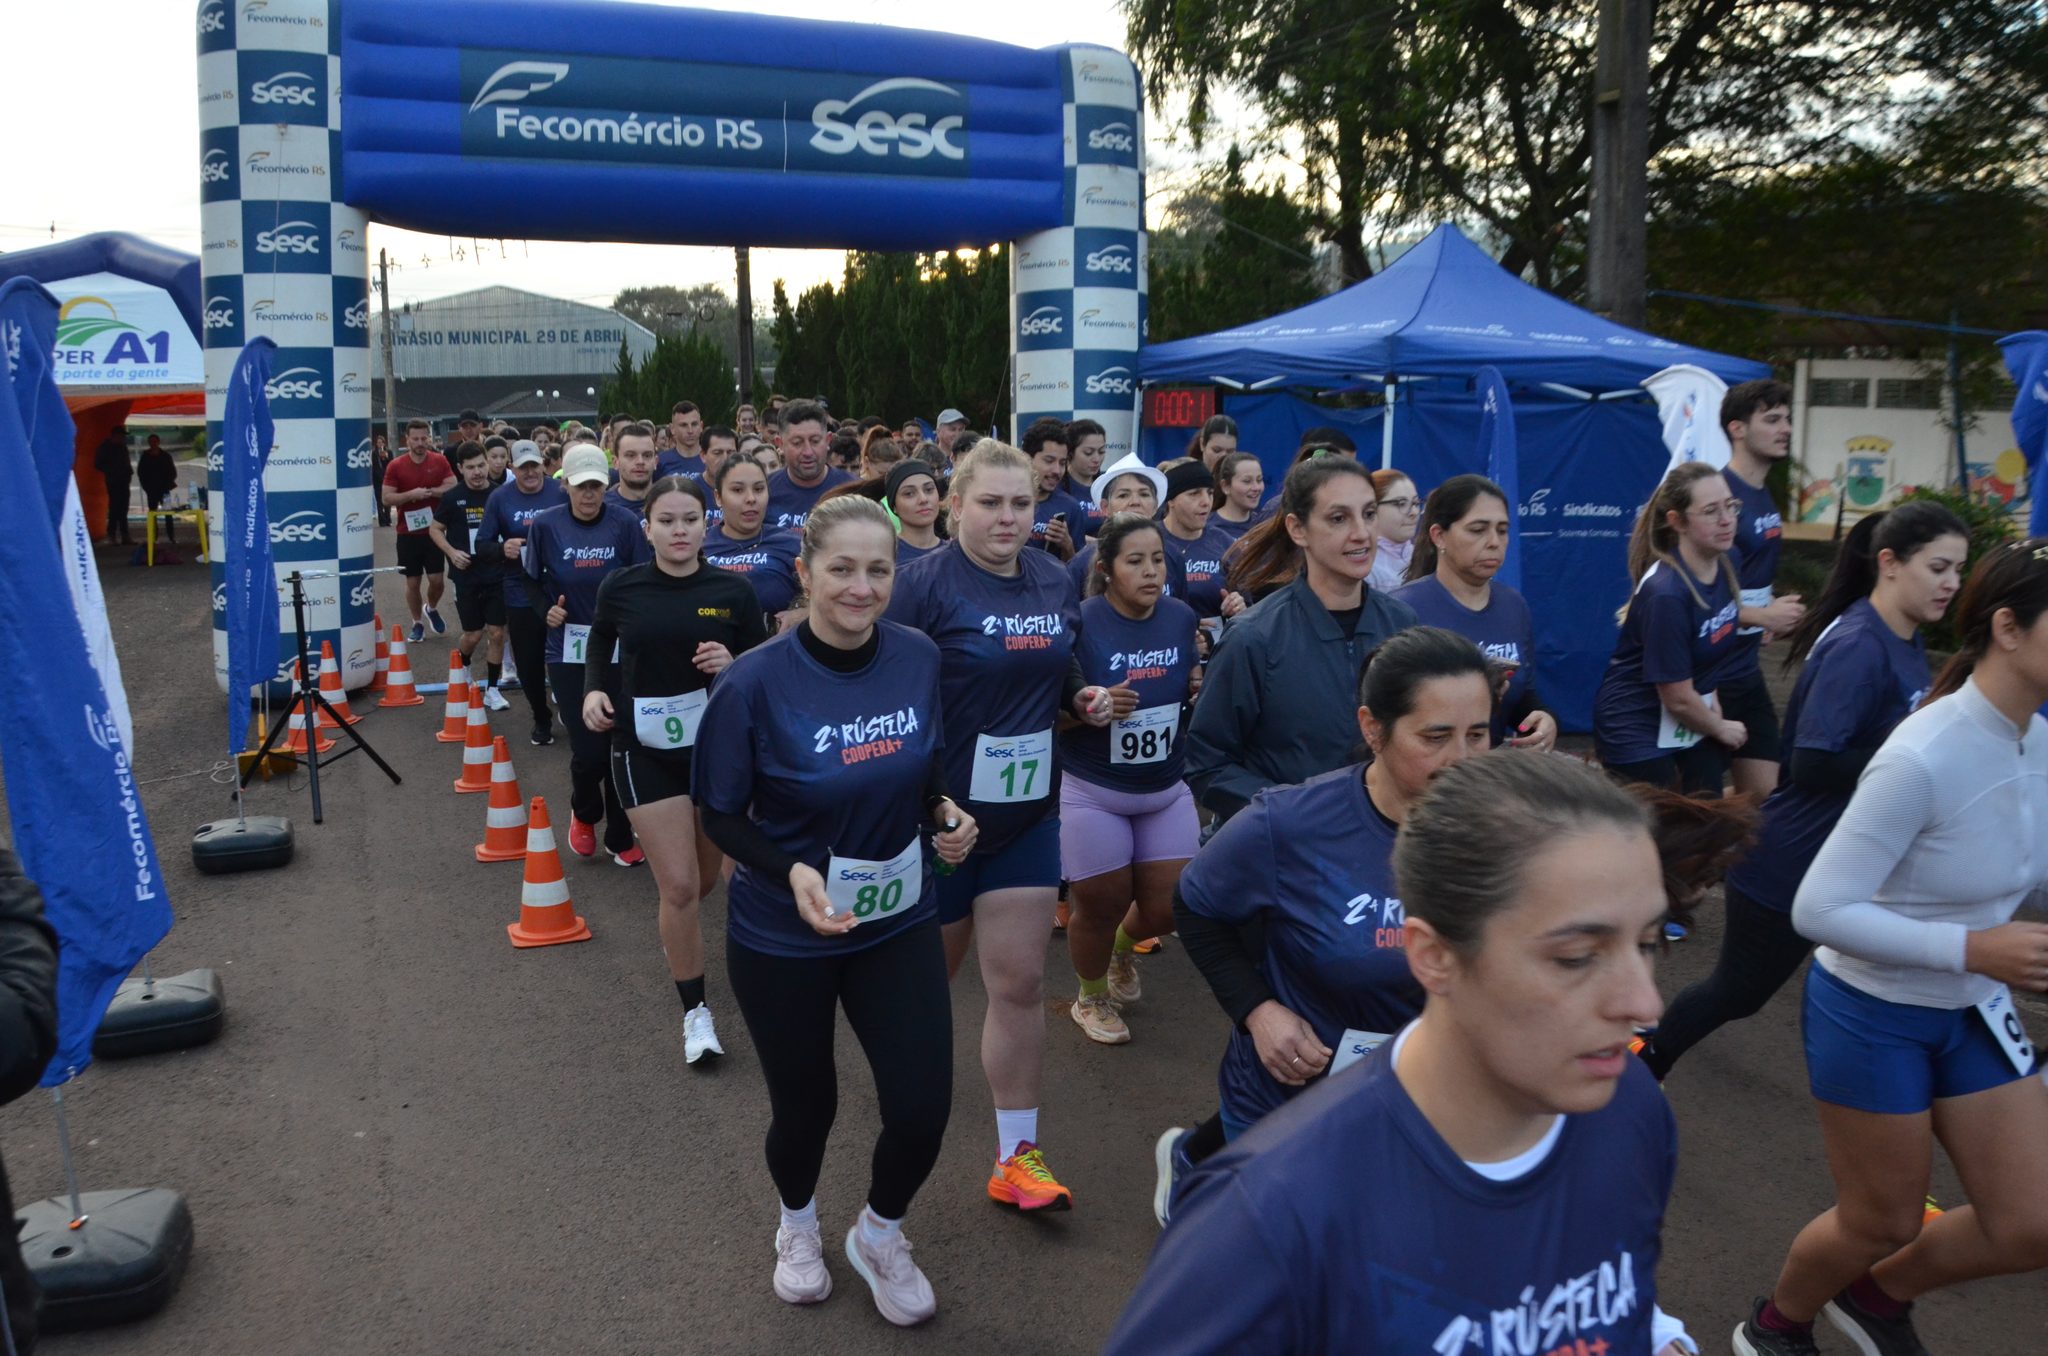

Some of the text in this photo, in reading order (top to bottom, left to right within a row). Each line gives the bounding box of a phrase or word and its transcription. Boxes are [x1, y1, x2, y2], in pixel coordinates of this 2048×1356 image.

[200, 11, 225, 33] esc
[247, 13, 324, 28] Fecomércio RS
[251, 81, 316, 107] Sesc
[496, 107, 763, 151] Fecomércio RS
[809, 99, 965, 160] Sesc
[1088, 129, 1133, 153] Sesc
[203, 162, 229, 183] esc
[251, 164, 326, 176] Fecomércio RS
[256, 231, 320, 254] Sesc
[1086, 252, 1132, 274] Sesc
[256, 311, 329, 321] Fecomércio RS
[1021, 316, 1063, 336] Sesc
[447, 330, 532, 346] MUNICIPAL
[537, 329, 557, 344] 29
[560, 329, 579, 344] DE
[584, 328, 623, 343] ABRIL
[103, 330, 170, 365] A1
[63, 367, 169, 381] parte da gente
[1085, 374, 1132, 394] Sesc
[264, 379, 323, 399] Sesc
[266, 456, 332, 467] ecomércio RS
[347, 448, 373, 468] Ses
[245, 478, 259, 549] Sindicatos
[1562, 502, 1623, 518] Sindicatos
[270, 521, 327, 543] Sesc
[413, 516, 428, 528] 54
[577, 546, 616, 560] RÚSTICA
[1185, 560, 1220, 574] ÚSTICA
[324, 596, 336, 605] RS
[1005, 613, 1063, 635] RÚSTICA
[1004, 635, 1053, 651] COOPERA+
[1128, 647, 1179, 669] RÚSTICA
[1126, 668, 1167, 681] COOPERA+
[641, 706, 665, 716] Sesc
[664, 715, 685, 744] 9
[841, 707, 919, 747] RÚSTICA
[1117, 719, 1143, 730] Sesc
[841, 738, 904, 765] COOPERA+
[984, 746, 1016, 759] Sesc
[1121, 726, 1171, 761] 981
[1000, 759, 1039, 797] 17
[113, 752, 156, 902] Fecomércio
[840, 869, 878, 881] Sesc
[852, 878, 904, 918] 80
[1489, 1251, 1638, 1356] RÚSTICA
